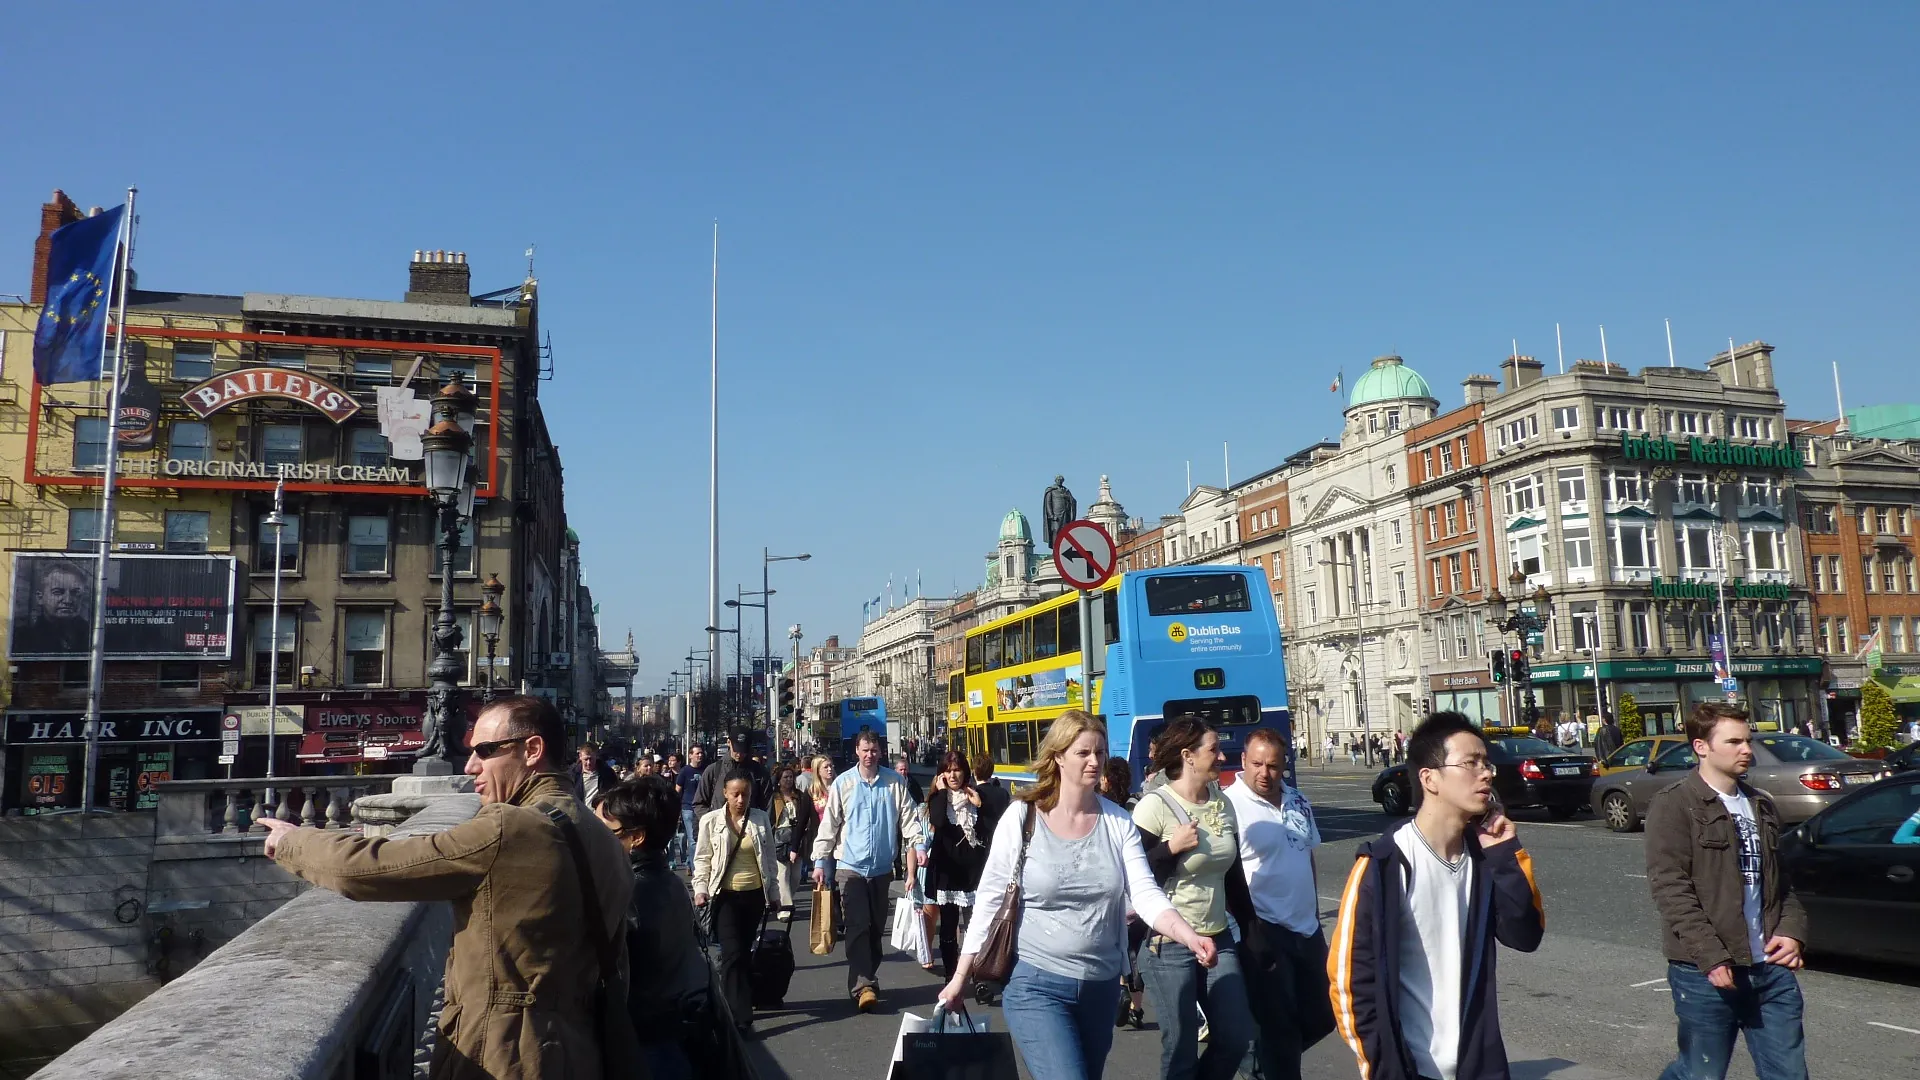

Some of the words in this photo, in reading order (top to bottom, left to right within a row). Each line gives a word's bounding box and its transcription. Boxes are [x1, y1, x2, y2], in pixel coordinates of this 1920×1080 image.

[195, 372, 344, 412] BAILEYS
[119, 407, 152, 419] AILEYS
[1622, 430, 1676, 461] Irish
[1689, 436, 1804, 469] Nationwide
[116, 457, 157, 474] THE
[165, 459, 271, 478] ORIGINAL
[278, 463, 331, 480] IRISH
[338, 464, 410, 482] CREAM
[1652, 577, 1716, 601] Building
[1734, 578, 1788, 599] Society
[1189, 627, 1220, 636] Dublin
[1222, 625, 1241, 634] Bus
[1209, 644, 1242, 652] community
[1675, 664, 1702, 673] IRISH
[1705, 663, 1764, 673] NONWIDE
[1200, 673, 1216, 685] 10
[1450, 676, 1464, 685] Ulster
[1464, 676, 1479, 685] Bank
[1728, 680, 1735, 690] P
[319, 711, 371, 728] Elverys
[376, 713, 417, 726] Sports
[140, 719, 202, 736] INC.
[28, 775, 66, 795] €15
